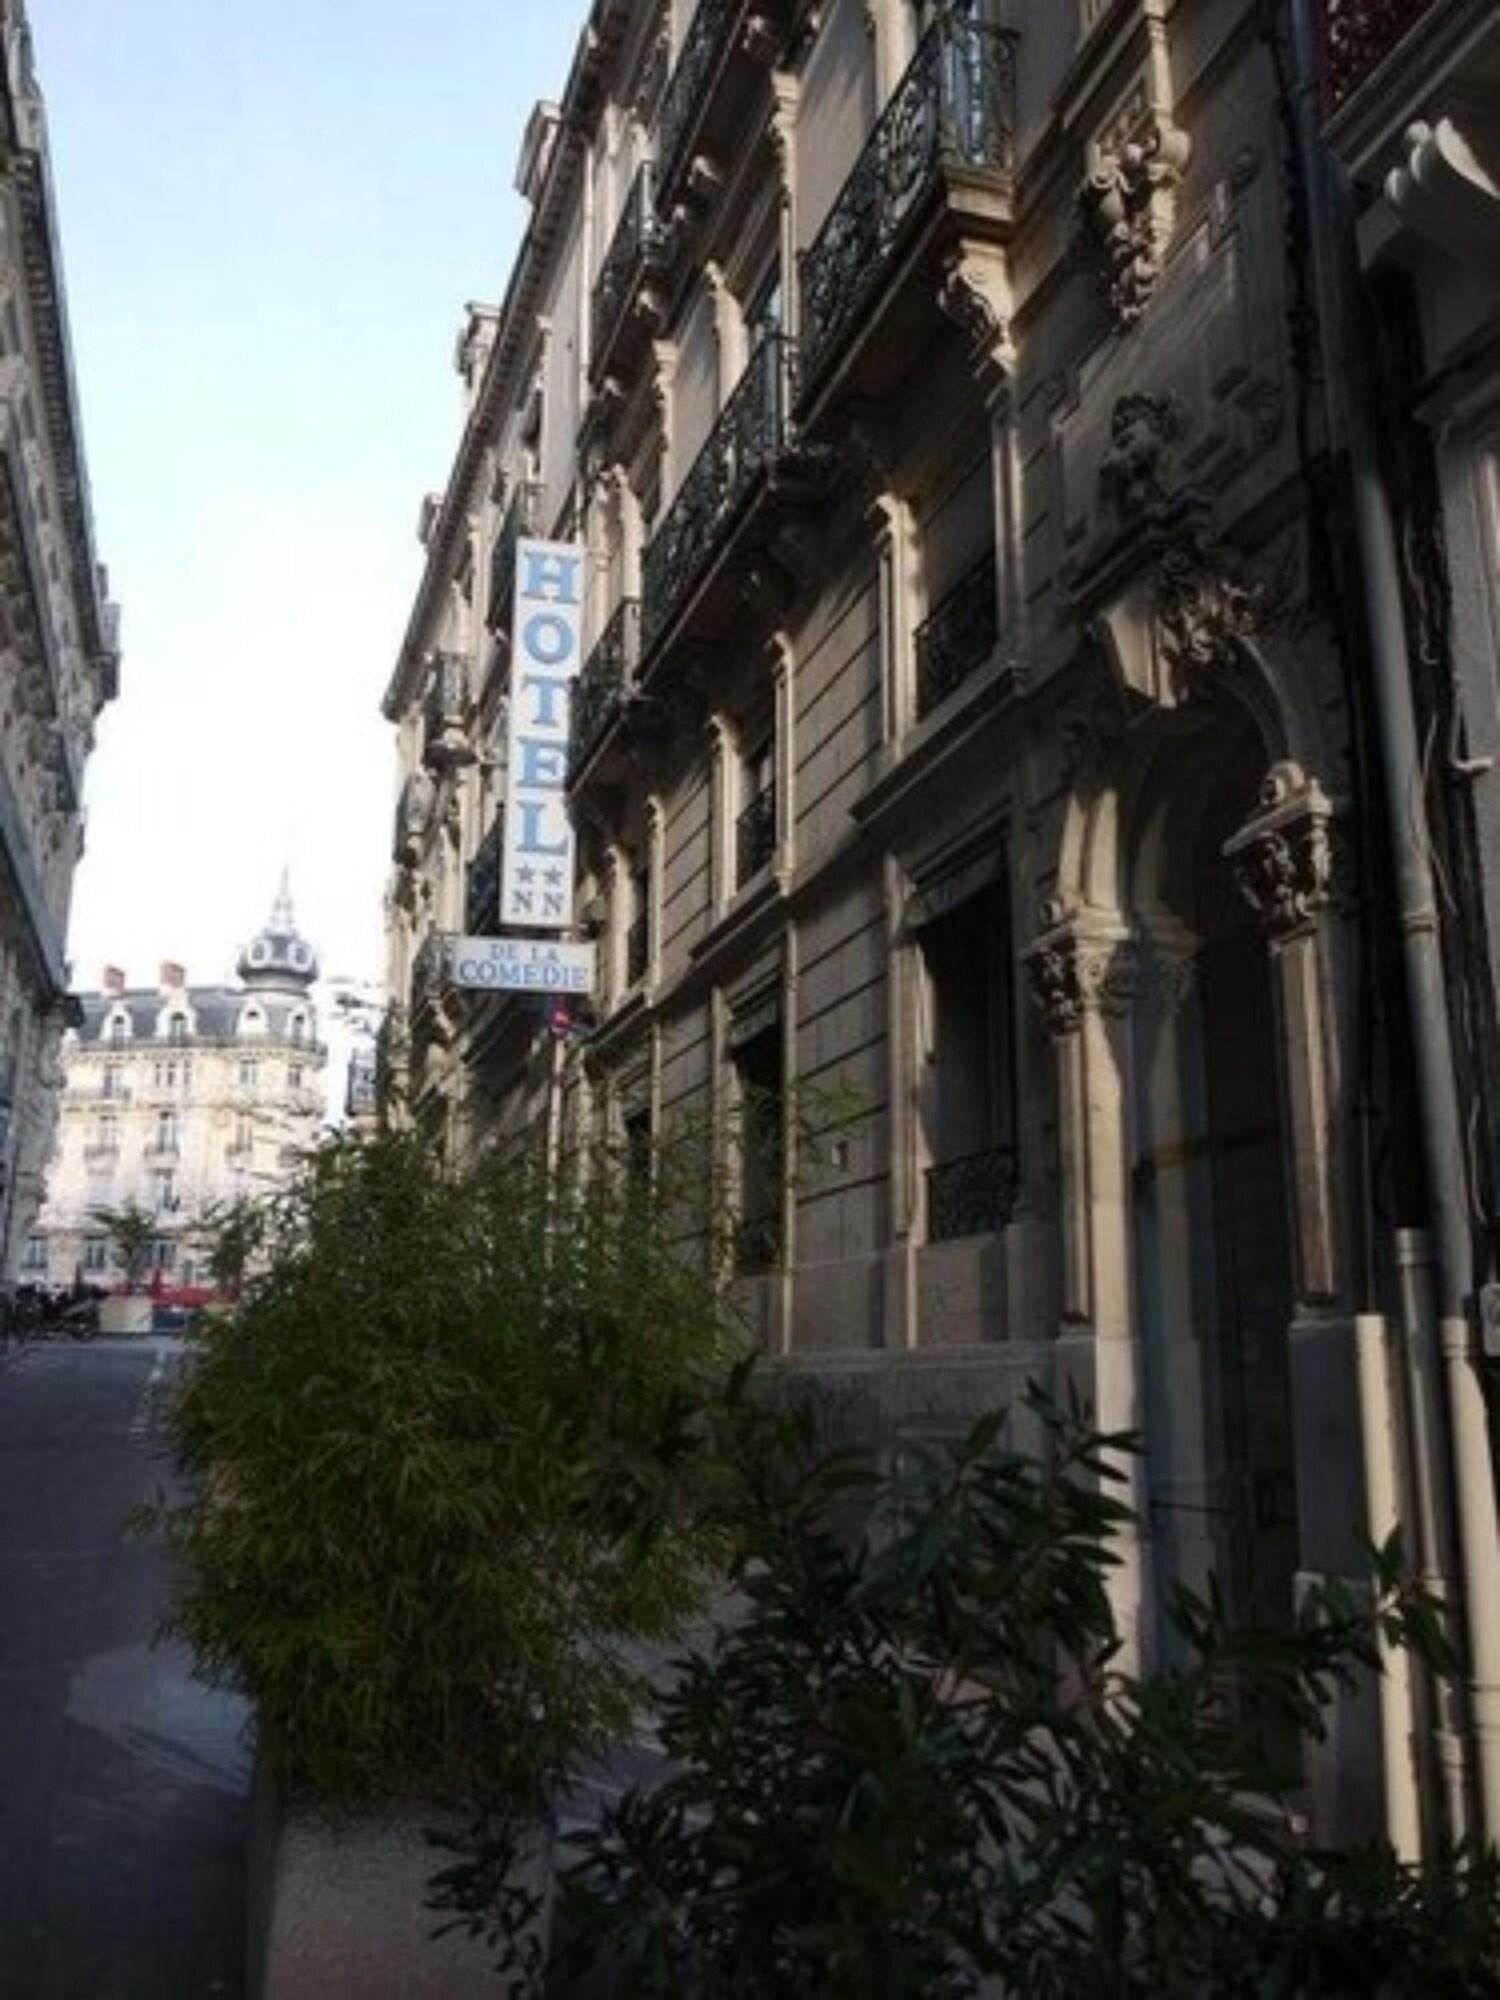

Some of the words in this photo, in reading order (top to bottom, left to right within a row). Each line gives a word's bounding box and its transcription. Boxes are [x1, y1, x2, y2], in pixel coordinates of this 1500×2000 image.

[516, 551, 580, 855] HOTEL
[491, 944, 517, 960] DE
[531, 947, 559, 962] LA
